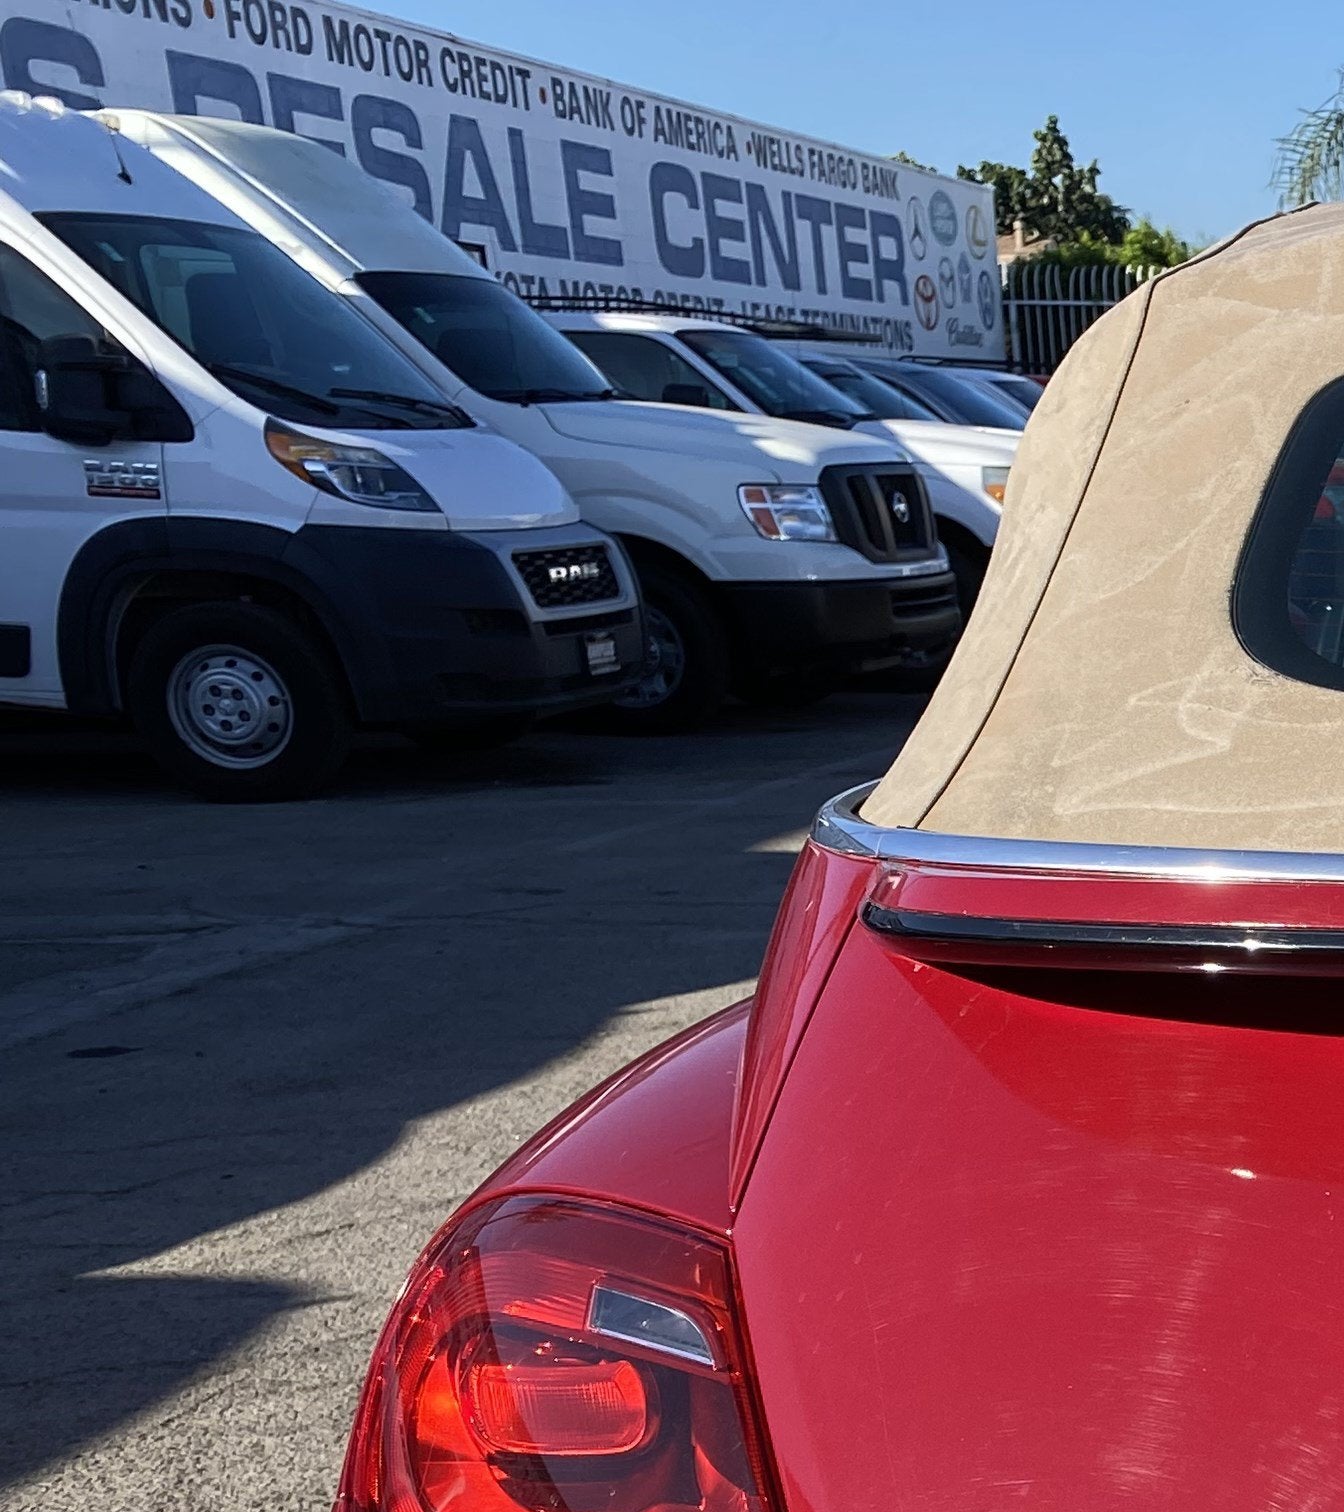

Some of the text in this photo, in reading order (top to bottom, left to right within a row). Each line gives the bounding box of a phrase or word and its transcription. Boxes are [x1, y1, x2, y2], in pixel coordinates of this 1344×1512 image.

[225, 0, 313, 55] FORD
[322, 16, 433, 87] MOTOR
[440, 47, 531, 111] CREDIT
[551, 77, 614, 132] BANK
[621, 97, 647, 138] OF
[653, 106, 738, 160] AMERICA
[752, 132, 804, 176] WELLS
[808, 149, 858, 190] FARGO
[862, 162, 900, 201] BANK
[495, 271, 551, 311] OTA
[559, 279, 644, 313] MOTOR
[650, 161, 909, 306] CENTER
